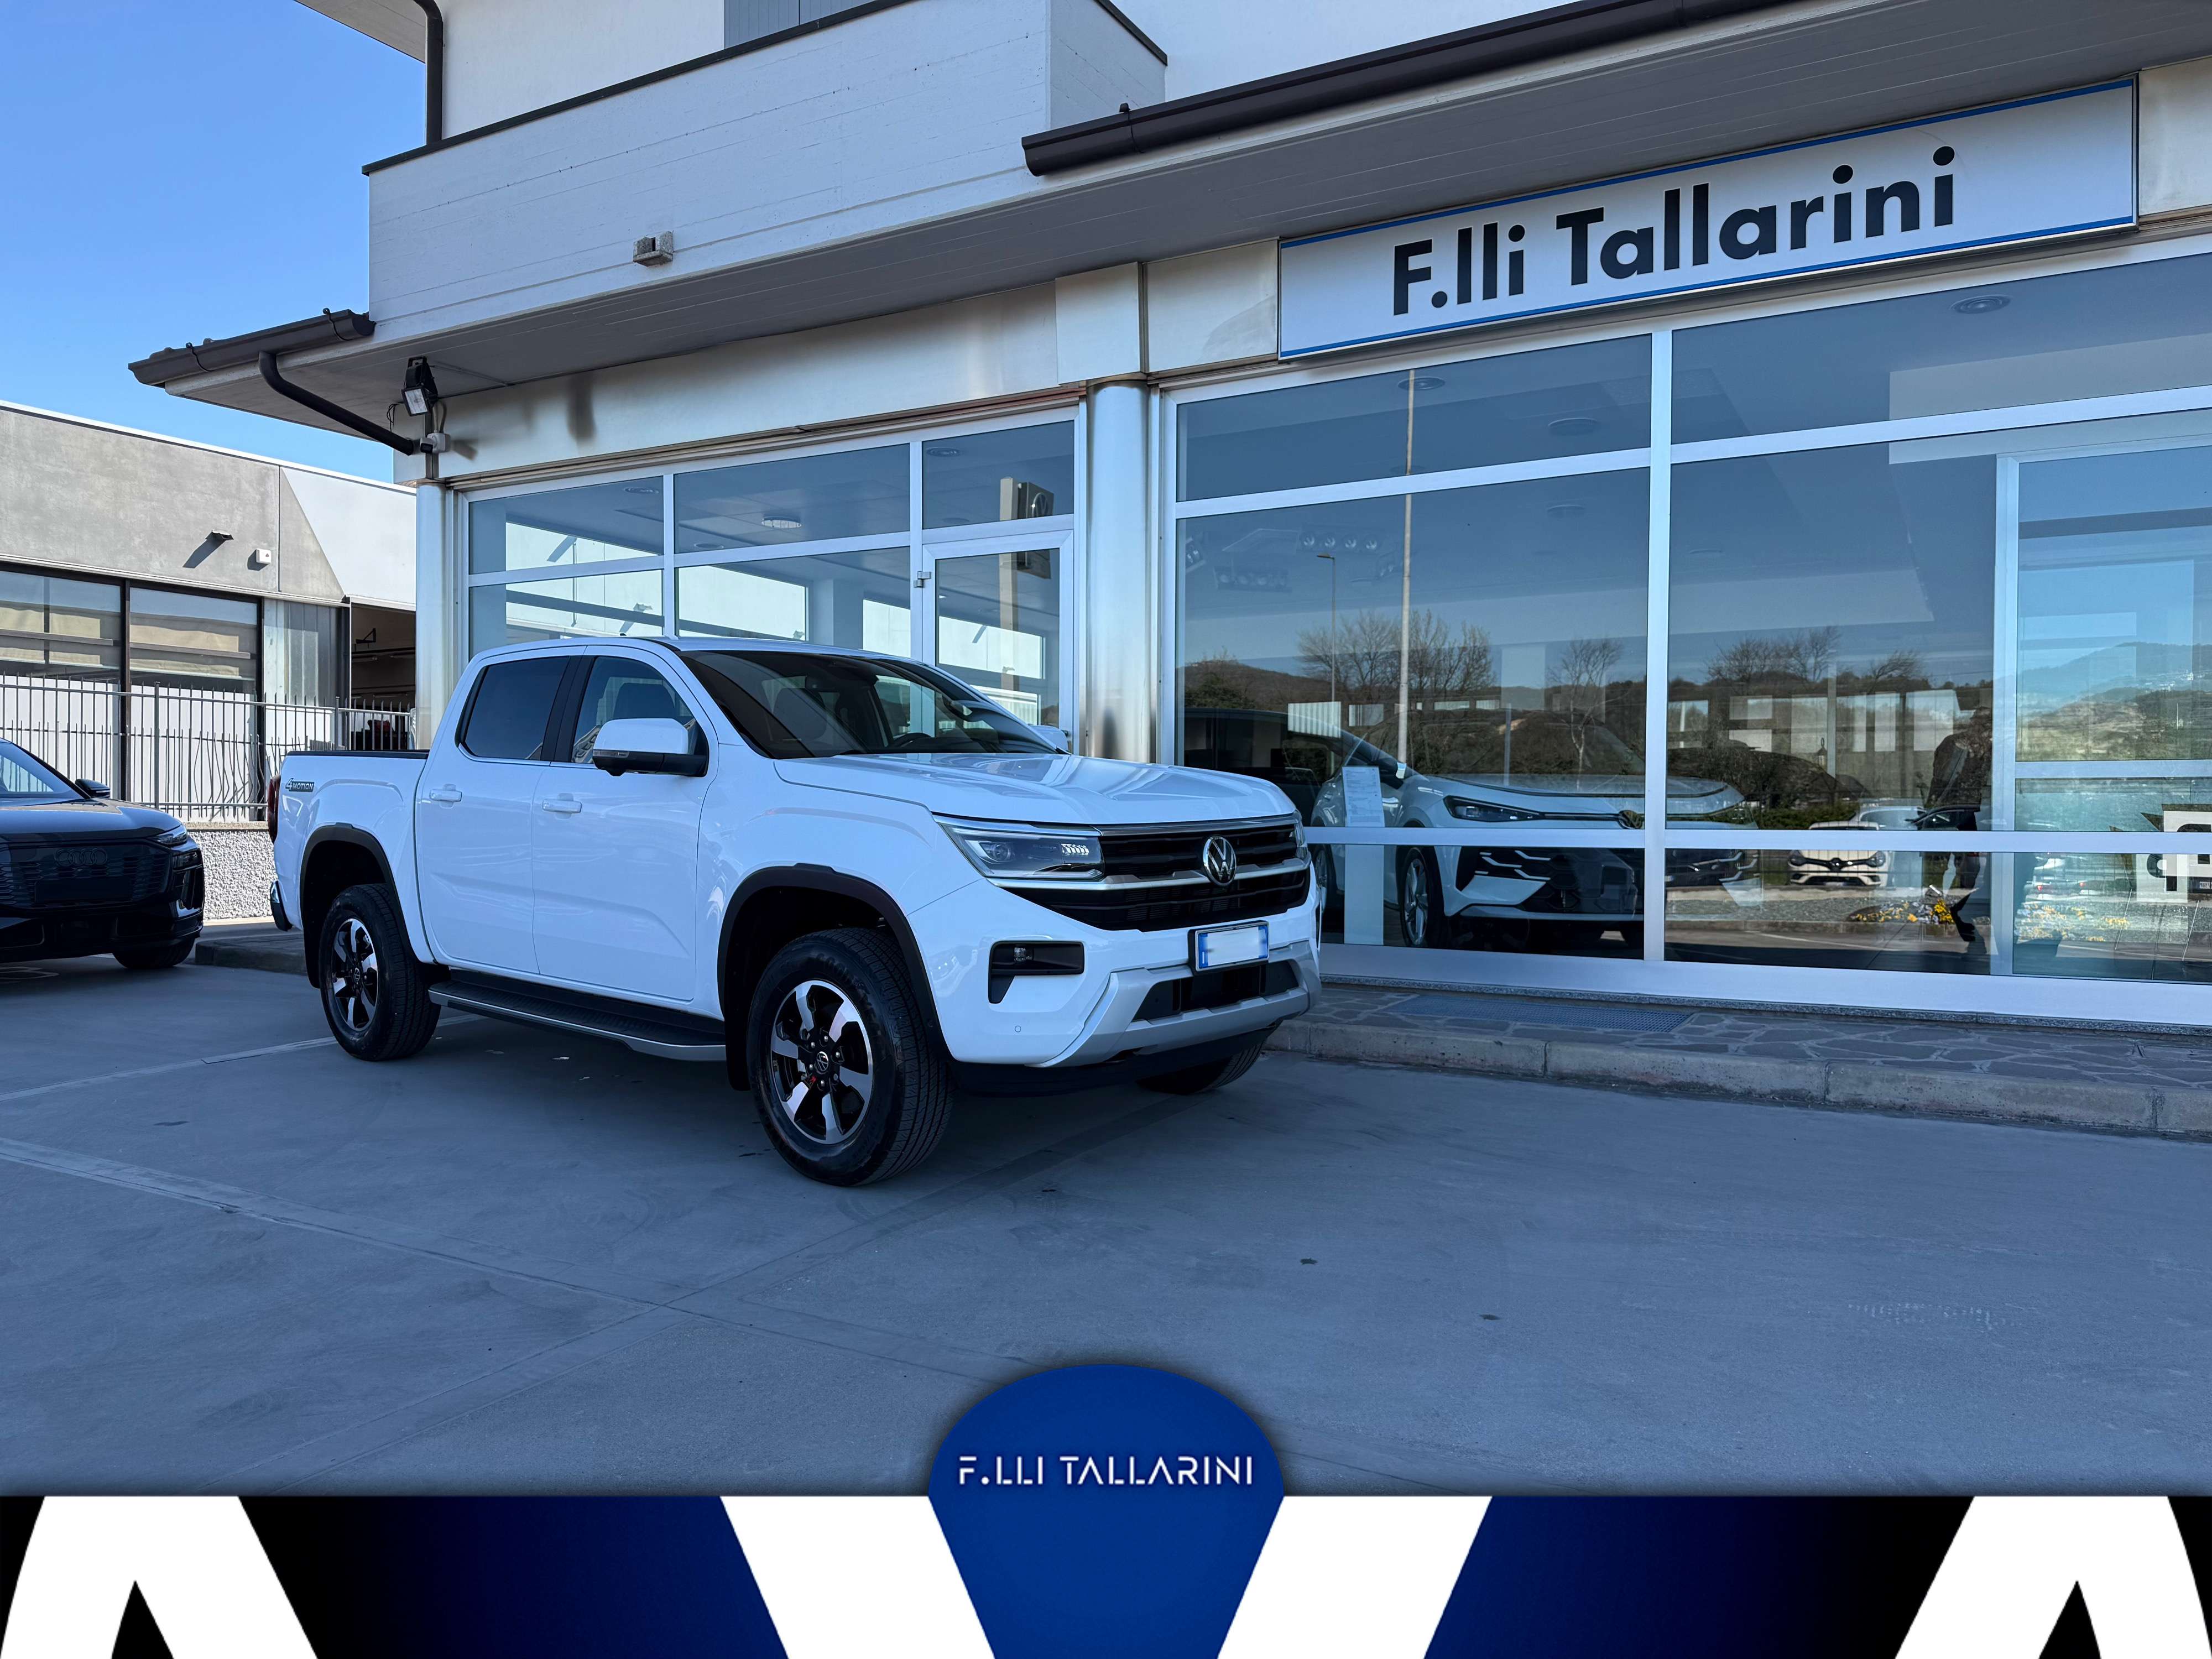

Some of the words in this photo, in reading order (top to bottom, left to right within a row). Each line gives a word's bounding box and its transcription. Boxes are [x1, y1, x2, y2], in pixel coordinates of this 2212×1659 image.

[1394, 222, 1525, 316] F.lli
[1556, 147, 1955, 286] Tallarini
[285, 777, 314, 791] 4MOTION
